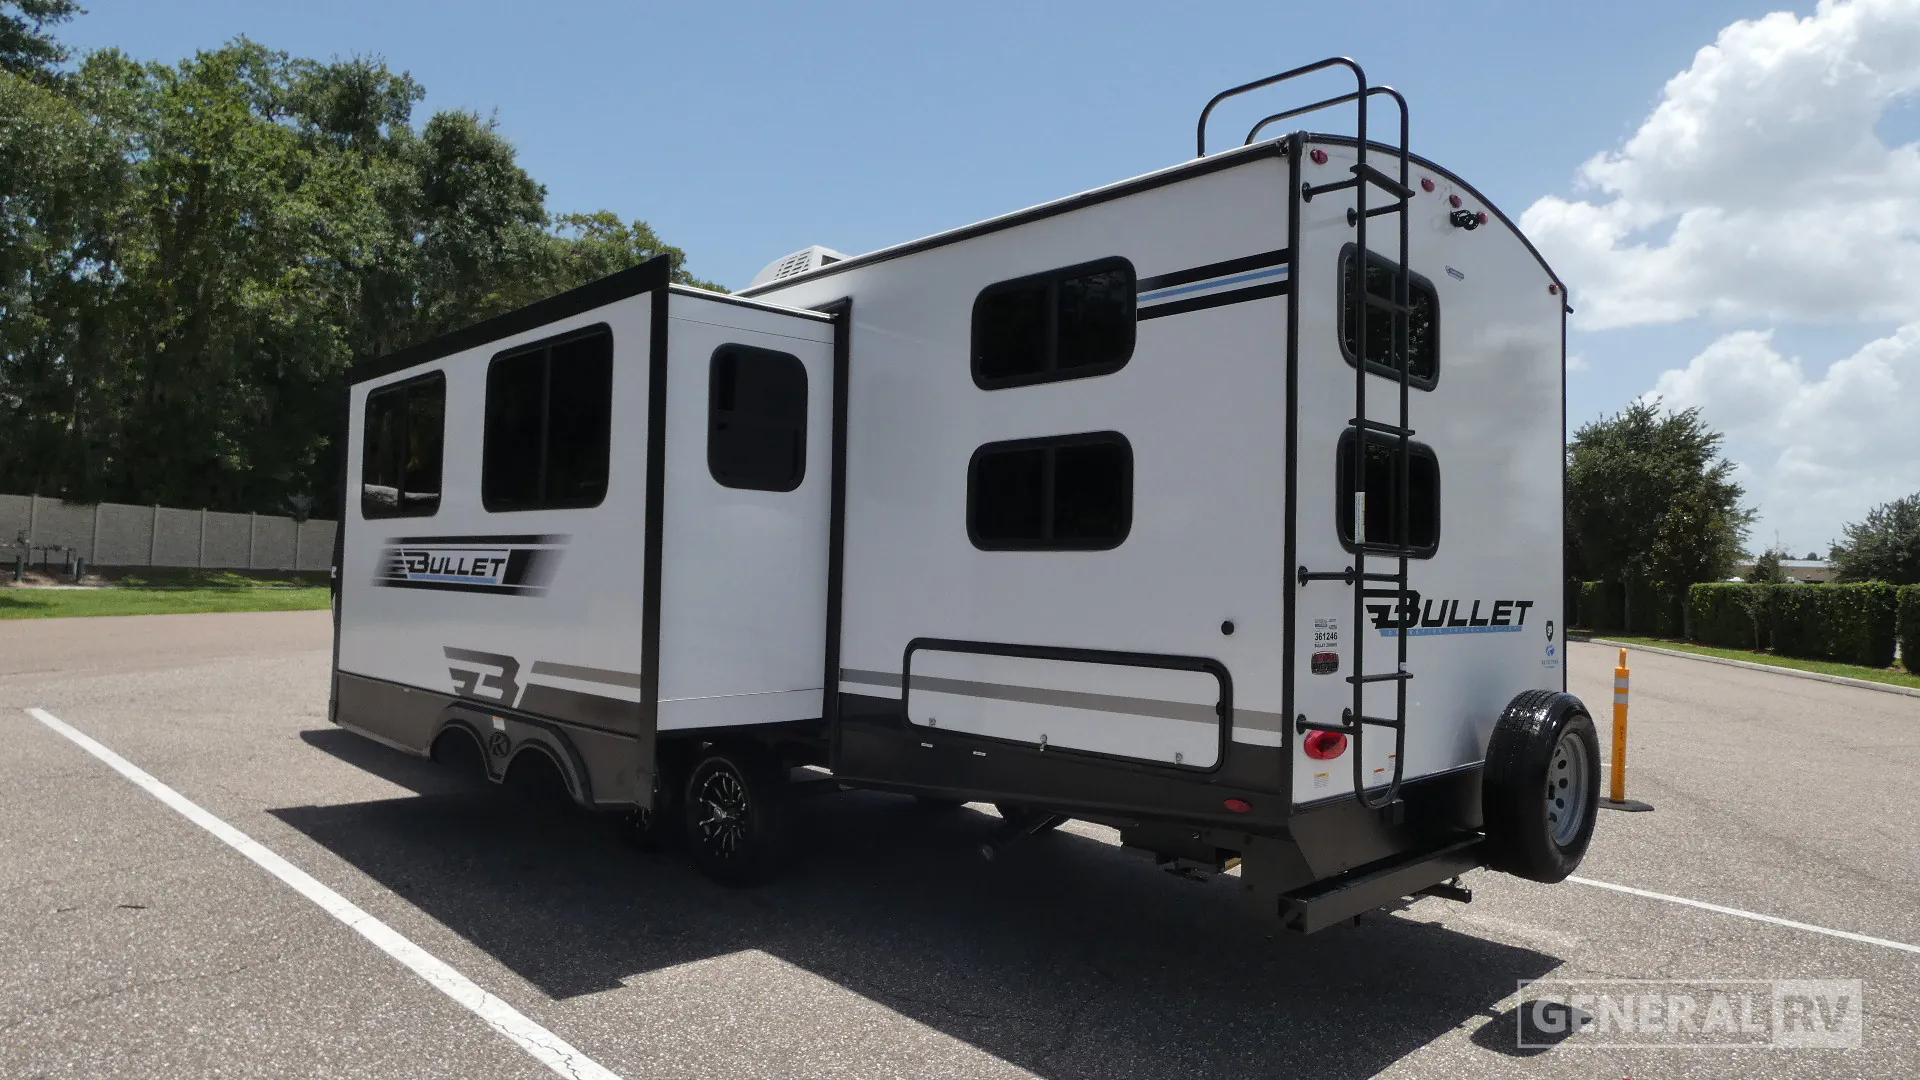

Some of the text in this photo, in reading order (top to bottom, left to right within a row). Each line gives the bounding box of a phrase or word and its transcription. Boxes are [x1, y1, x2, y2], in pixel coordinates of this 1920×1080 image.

[402, 551, 506, 577] BULLET
[1364, 589, 1533, 629] BULLET
[1314, 632, 1338, 641] 361246
